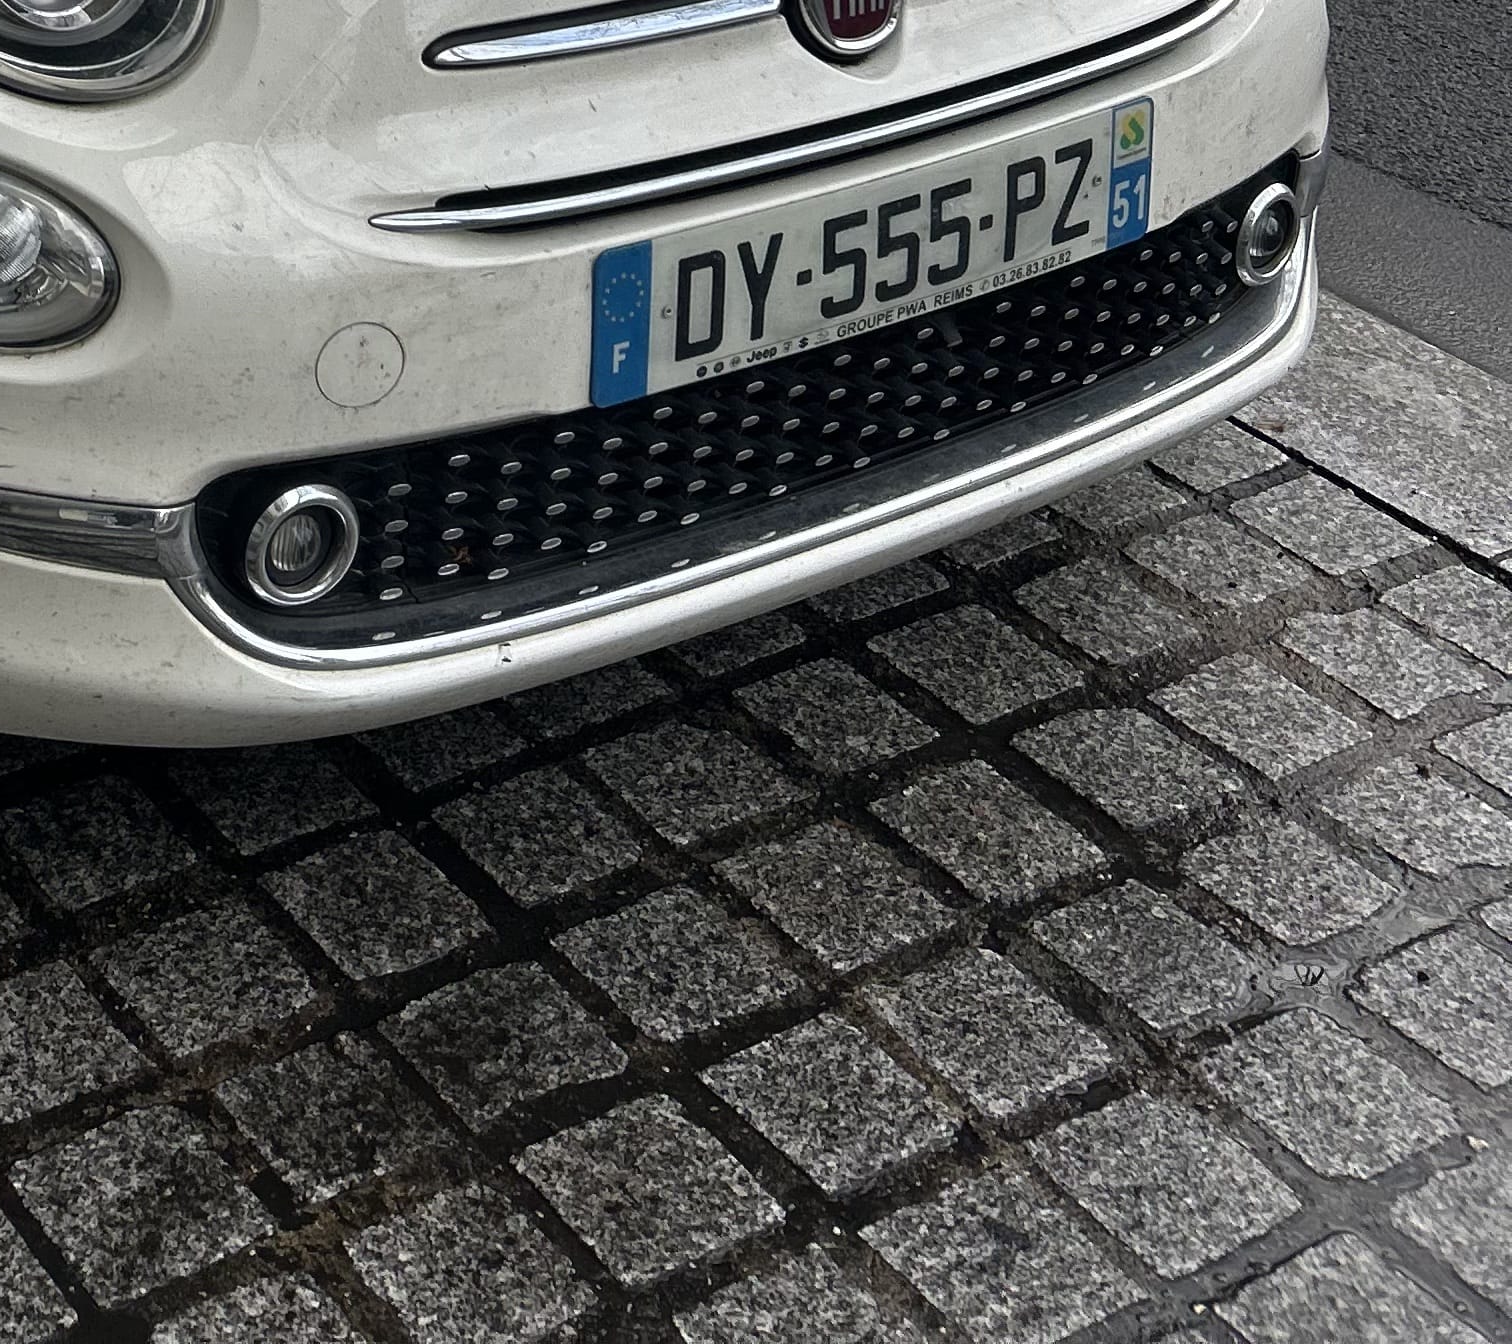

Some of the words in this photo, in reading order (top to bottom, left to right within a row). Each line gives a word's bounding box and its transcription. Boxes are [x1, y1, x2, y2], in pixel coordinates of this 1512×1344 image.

[1112, 173, 1146, 229] 51
[746, 345, 778, 363] Jeep
[836, 309, 894, 338] GROUPE
[896, 302, 927, 320] PWA
[933, 284, 974, 308] REIMS
[612, 340, 631, 375] F
